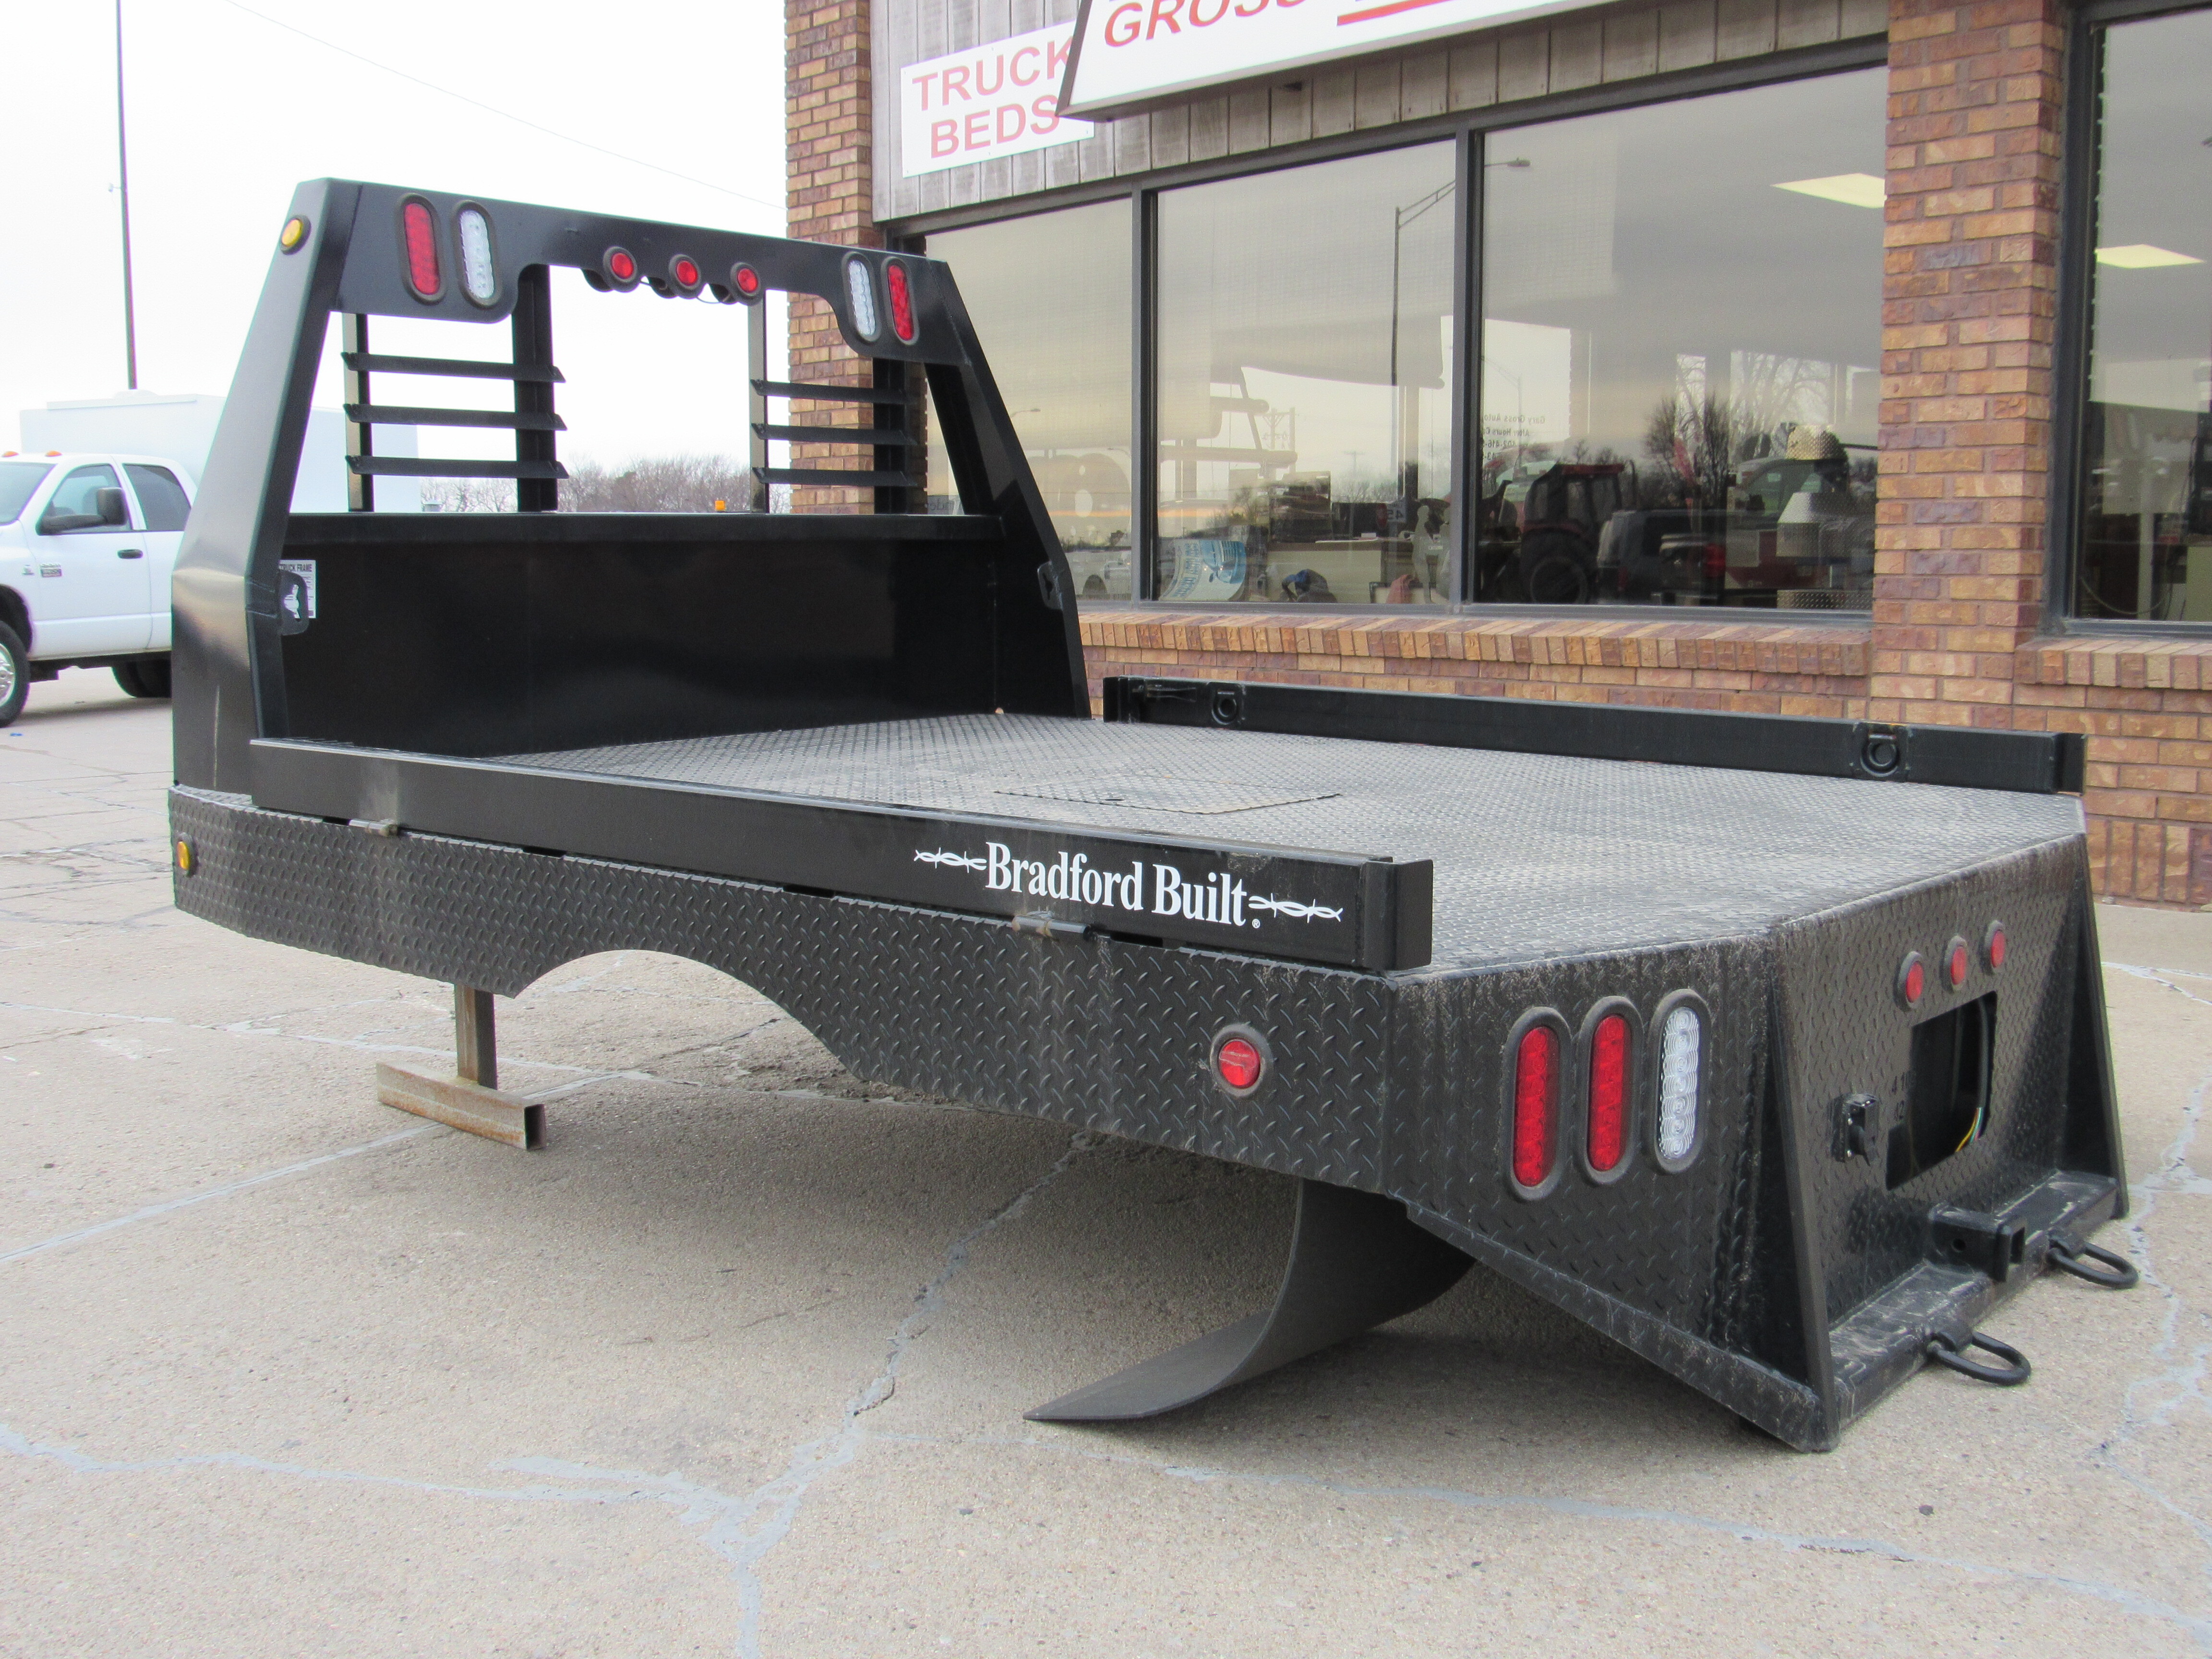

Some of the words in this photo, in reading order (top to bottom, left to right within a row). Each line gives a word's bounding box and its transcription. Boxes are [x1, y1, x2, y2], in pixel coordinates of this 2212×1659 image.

[1105, 0, 1307, 47] GRO
[912, 36, 1073, 111] TRUCK
[931, 95, 1060, 158] BEDS
[986, 842, 1143, 911] Bradford
[1152, 864, 1247, 926] Built
